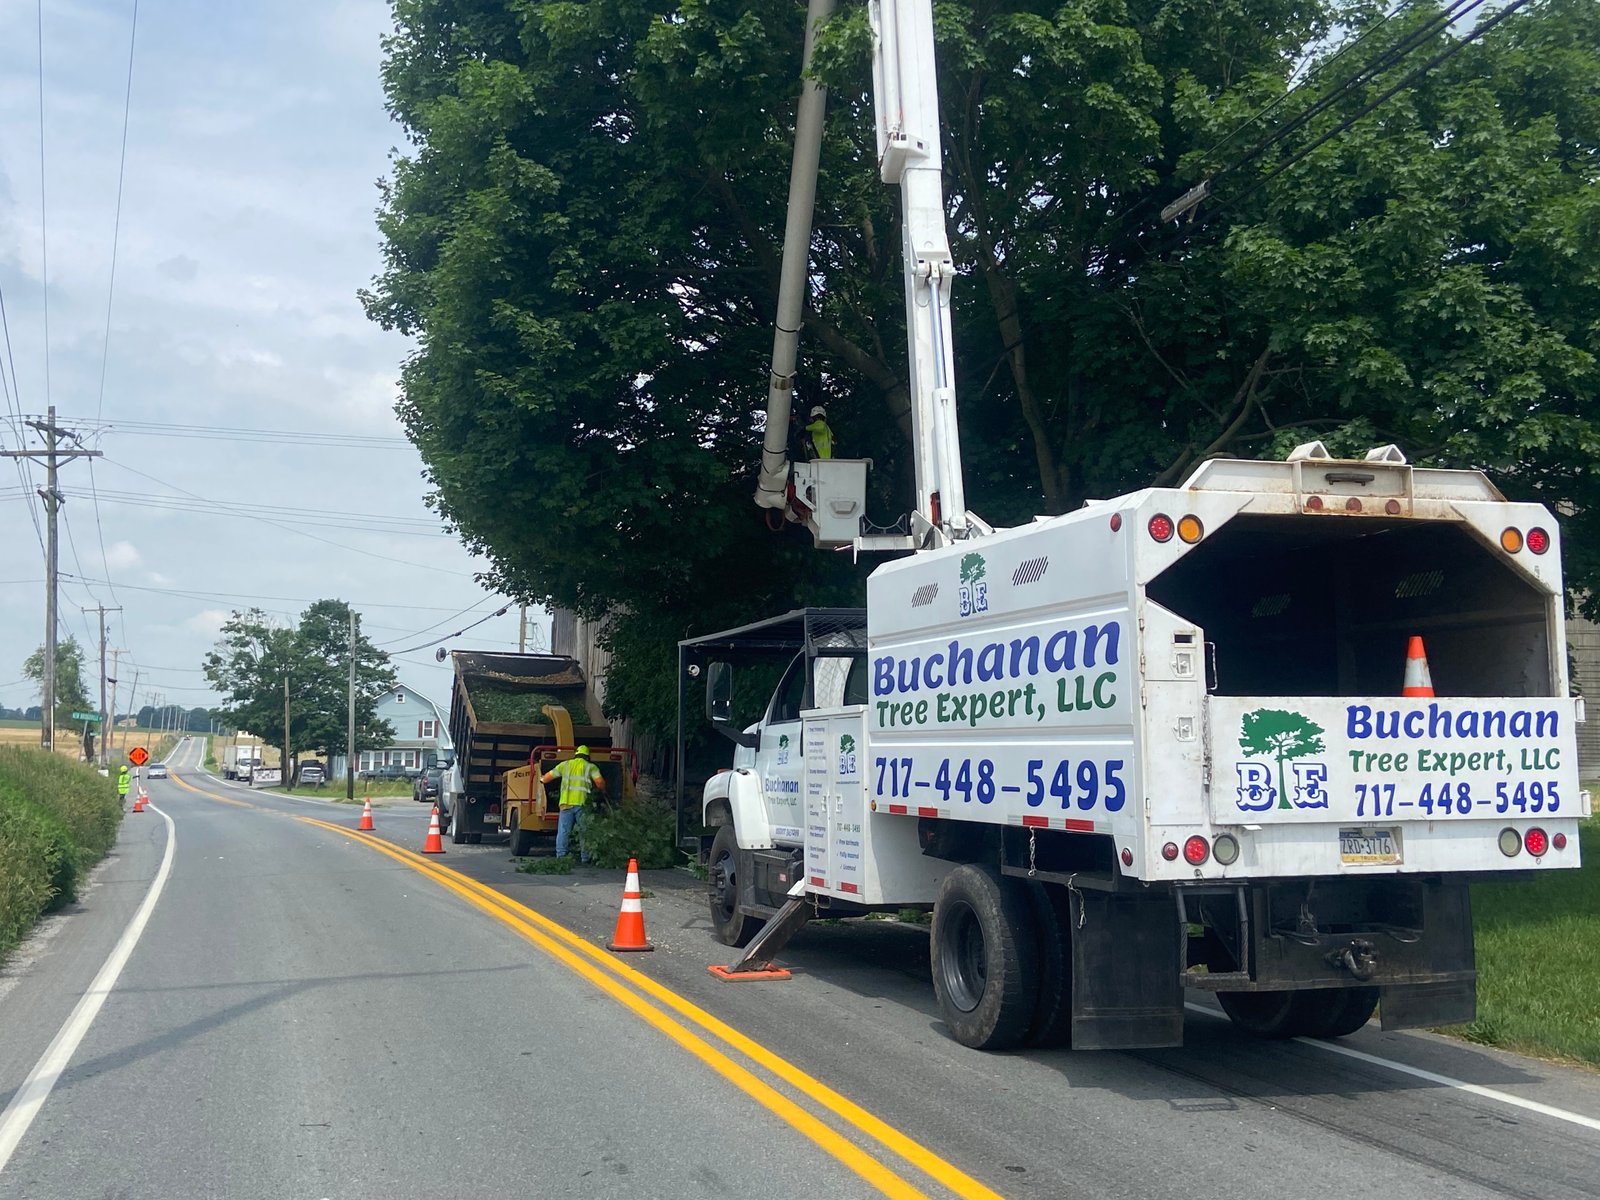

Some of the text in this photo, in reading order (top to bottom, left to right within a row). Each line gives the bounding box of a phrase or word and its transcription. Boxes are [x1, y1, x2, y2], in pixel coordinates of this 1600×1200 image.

[873, 621, 1120, 696] Buchanan
[876, 671, 1117, 727] Tree Expert, LLC
[1346, 703, 1558, 739] Buchanan
[1349, 748, 1561, 776] Tree Expert, LLC
[765, 777, 799, 793] Buchanan
[875, 757, 1126, 812] 717-448-5495
[1354, 781, 1561, 817] 717-448-5495
